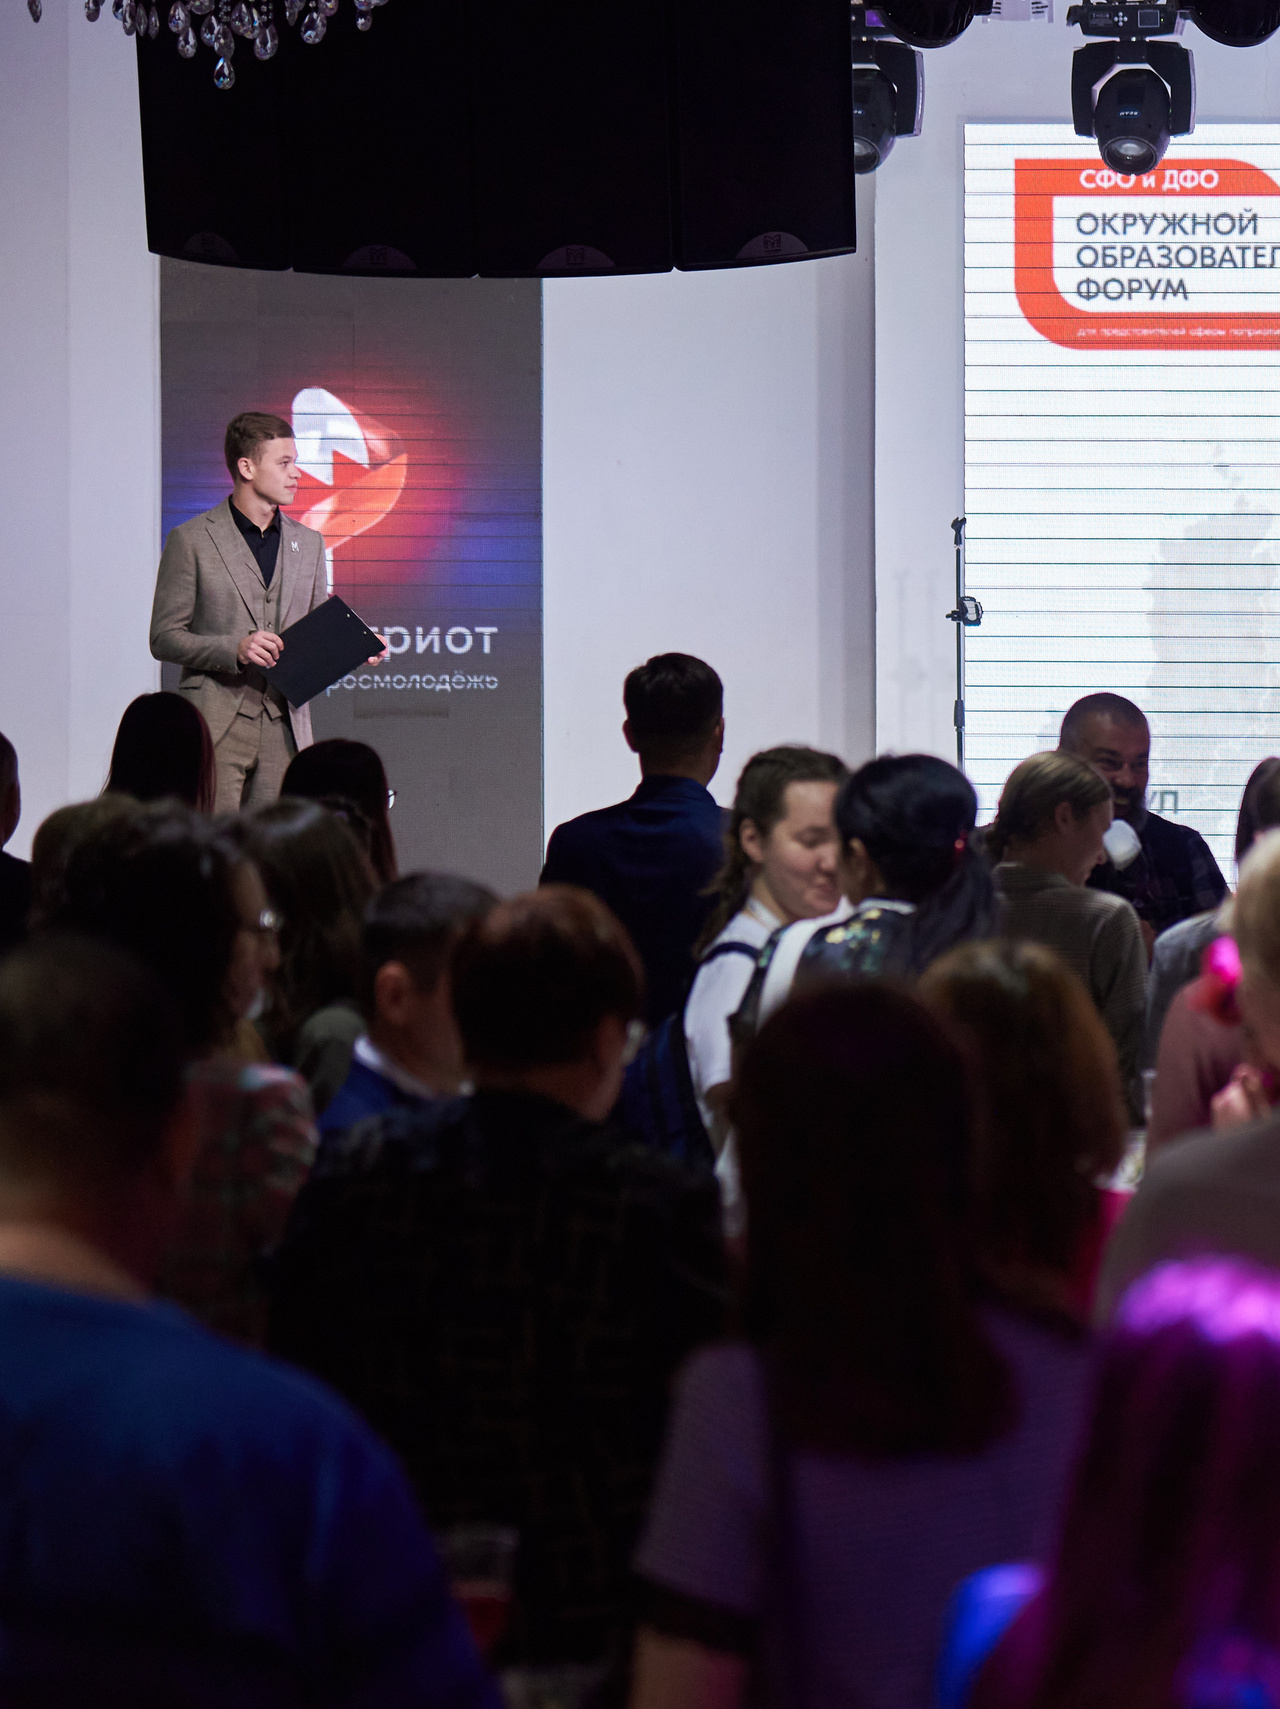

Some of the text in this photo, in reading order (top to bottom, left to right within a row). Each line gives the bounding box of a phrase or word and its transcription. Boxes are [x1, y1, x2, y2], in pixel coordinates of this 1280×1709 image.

[1080, 168, 1219, 191] СФО и ДФО
[1076, 209, 1258, 236] ОКРУЖНОЙ
[1076, 276, 1190, 300] ФОРУМ
